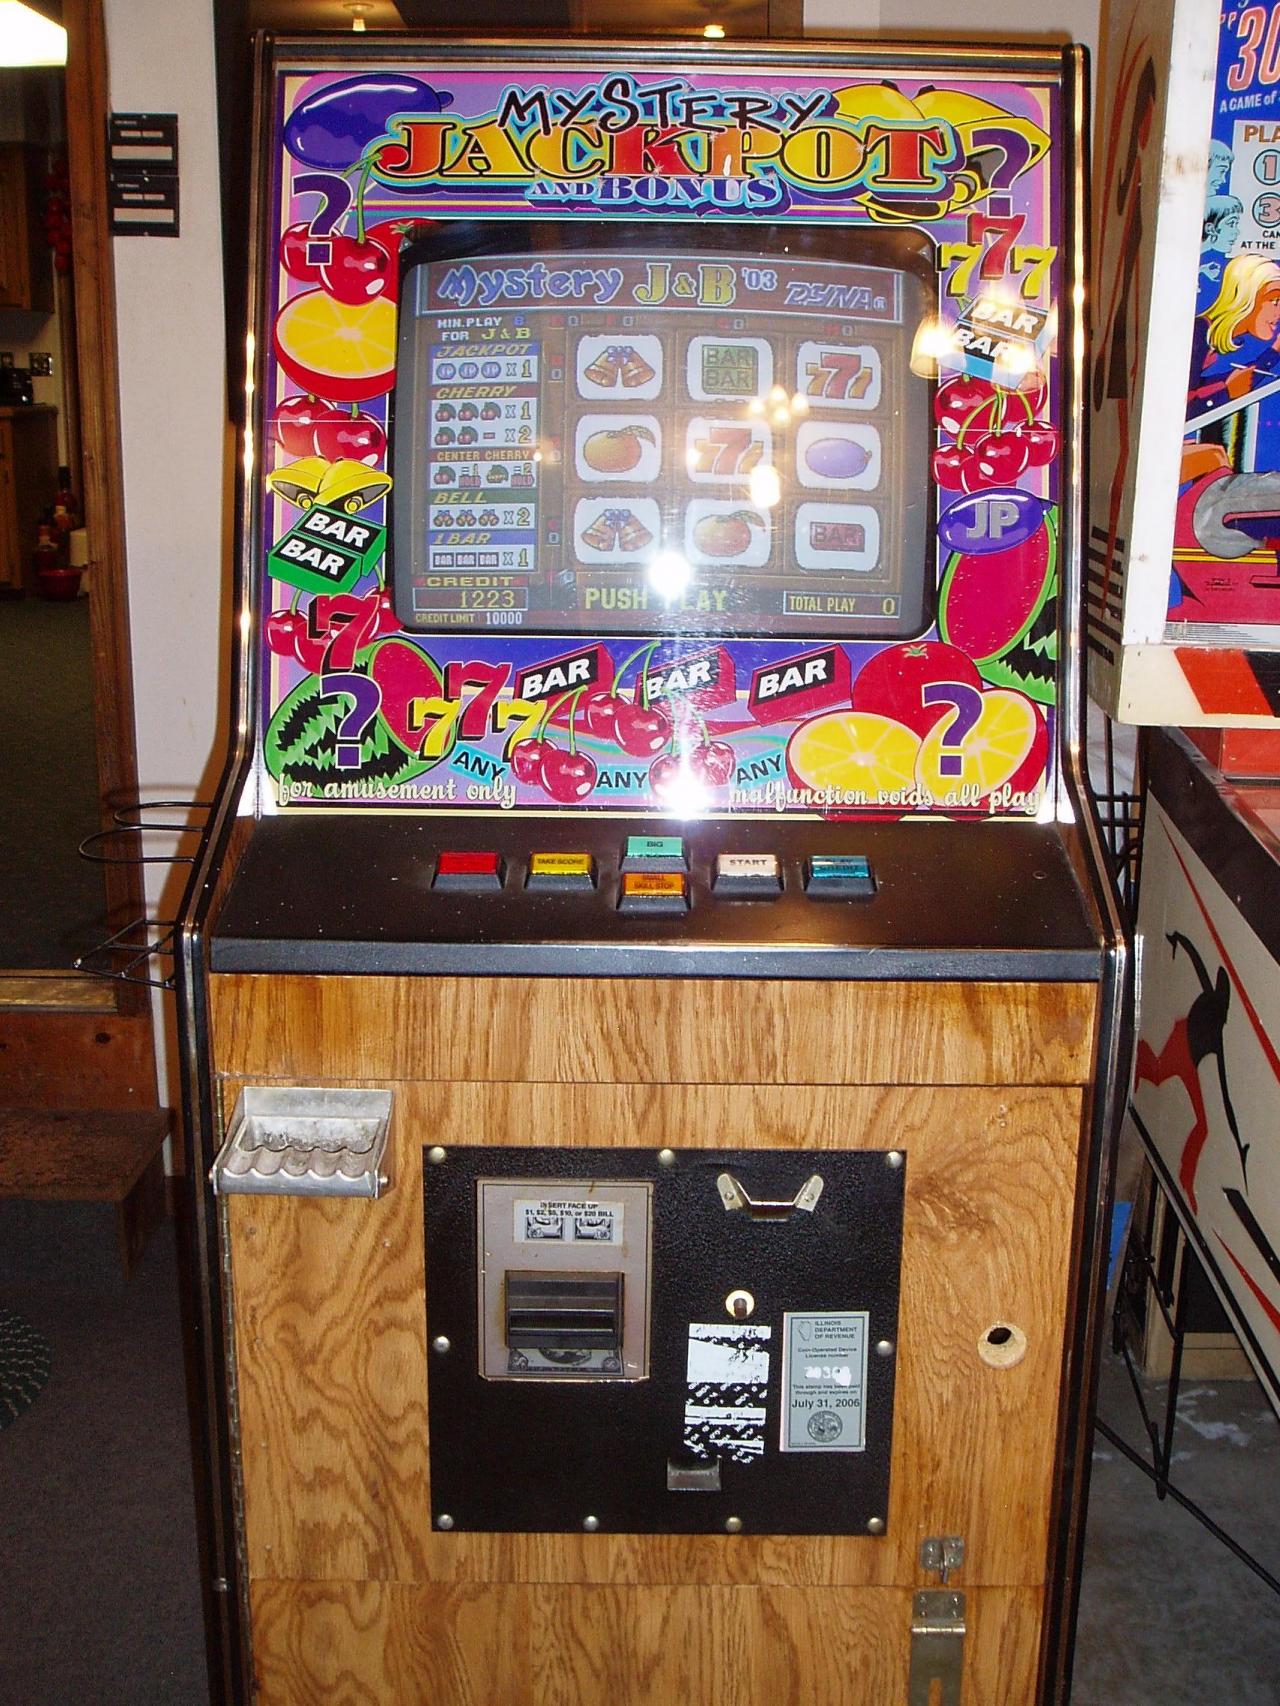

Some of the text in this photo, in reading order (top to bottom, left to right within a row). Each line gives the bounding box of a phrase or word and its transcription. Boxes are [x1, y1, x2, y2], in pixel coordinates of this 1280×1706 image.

[498, 78, 826, 136] MYSTERY
[1220, 91, 1277, 113] A GAME of
[373, 119, 948, 184] JACKPOT
[530, 176, 779, 201] AND BONUS
[1241, 241, 1252, 249] AT
[437, 262, 623, 306] Mystery
[632, 263, 736, 306] J&B
[741, 267, 778, 290] '03
[437, 317, 502, 329] MIN.PLAY
[970, 302, 1040, 334] BAR
[441, 332, 469, 341] FOR
[436, 344, 531, 357] JACKPOT
[706, 349, 752, 366] BAR
[704, 369, 750, 387] BAR
[436, 386, 517, 399] CHERRY
[437, 451, 529, 461] CENTER CHERRY
[434, 492, 487, 503] BELL
[966, 501, 1020, 538] JP
[305, 512, 370, 548] BAR
[447, 533, 492, 545] BAR
[814, 526, 862, 546] BAR
[280, 538, 345, 576] BAR
[426, 577, 514, 587] CREDIT
[461, 590, 516, 609] 1223
[585, 588, 648, 610] PUSH
[789, 595, 896, 615] TOTAL PLAY 0
[416, 611, 522, 625] CREDIT LIMIT 10000
[521, 658, 592, 699] BAR
[646, 659, 712, 701] BAR
[757, 657, 829, 699] BAR
[453, 750, 506, 782] ANY
[736, 755, 783, 784] ANY
[596, 771, 648, 788] ANY
[278, 773, 517, 809] for amusement only
[729, 781, 1044, 815] malfunction voids all play
[537, 858, 584, 866] TAKE SCORE
[729, 858, 768, 866] START
[791, 1398, 860, 1409] July 31, 2006
